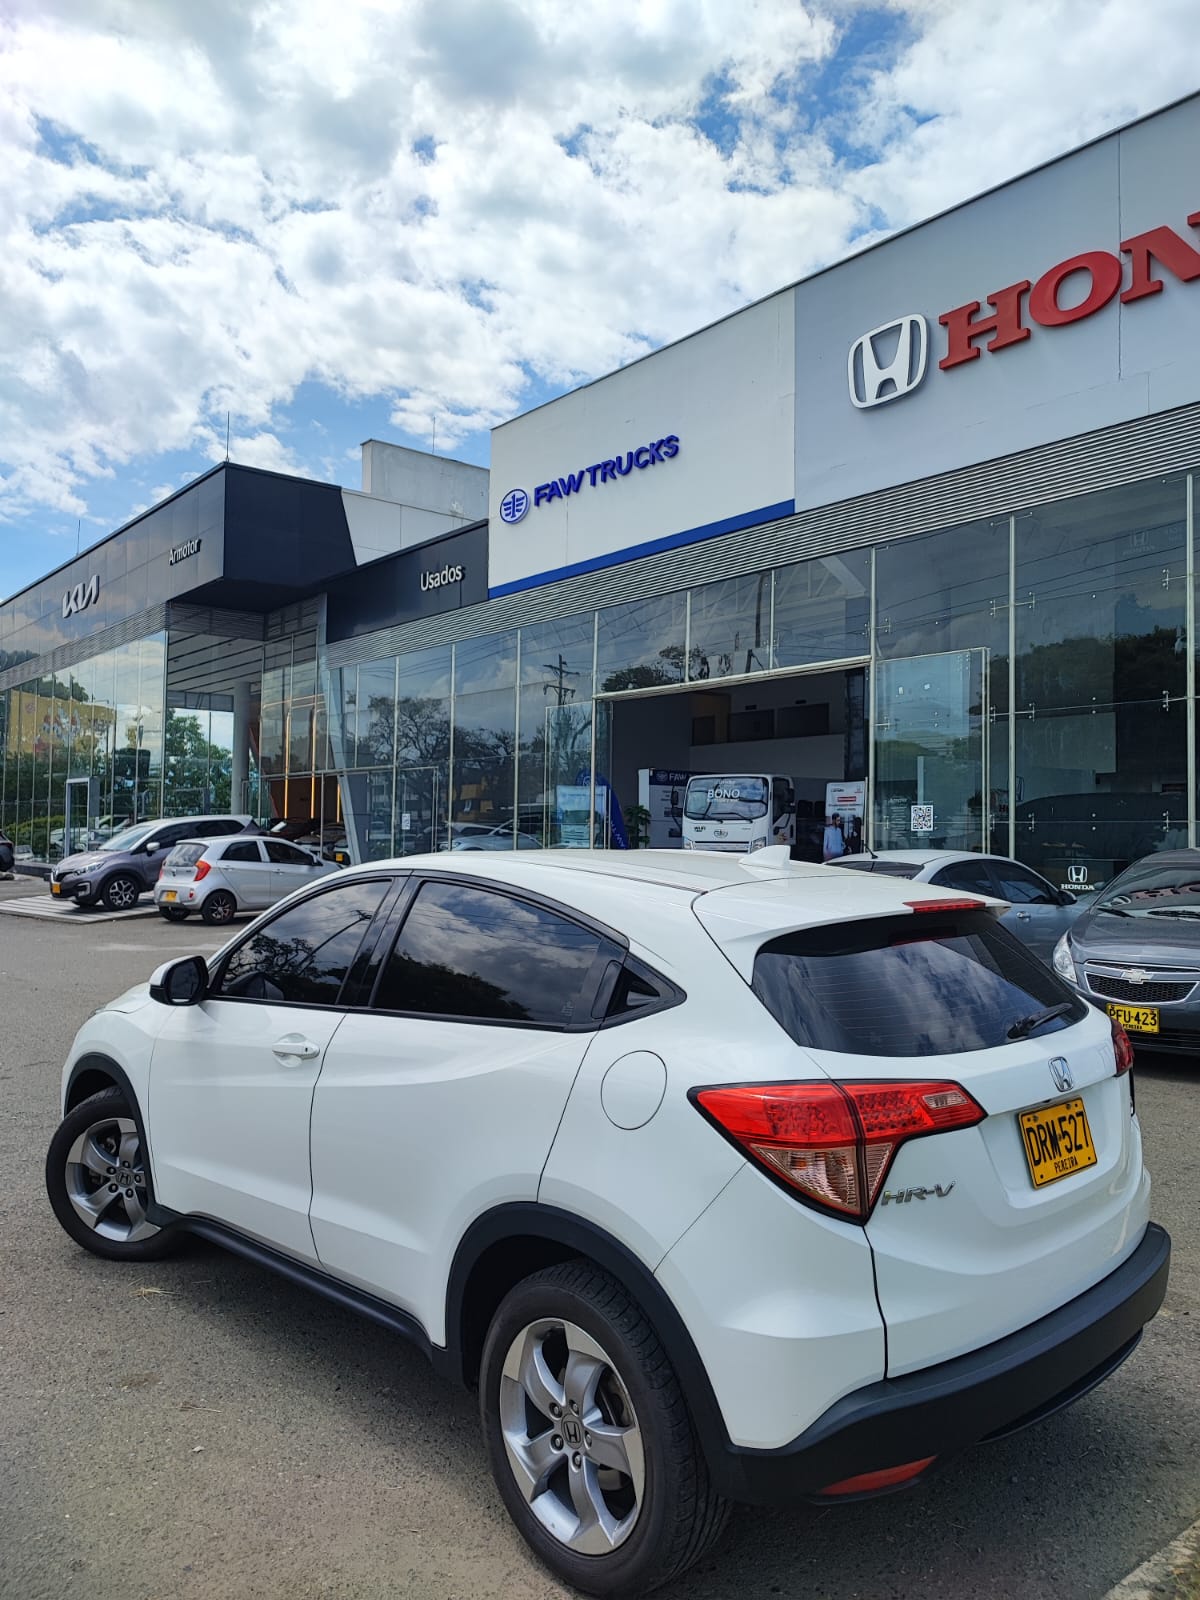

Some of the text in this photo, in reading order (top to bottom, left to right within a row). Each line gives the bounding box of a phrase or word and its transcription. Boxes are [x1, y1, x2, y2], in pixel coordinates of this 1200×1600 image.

[534, 434, 680, 507] FAW TRUCKS
[169, 539, 201, 566] Armotor
[420, 564, 465, 591] Usados
[707, 788, 740, 799] BONO
[1053, 1155, 1079, 1174] PEREIRA
[881, 1180, 957, 1206] HR-V
